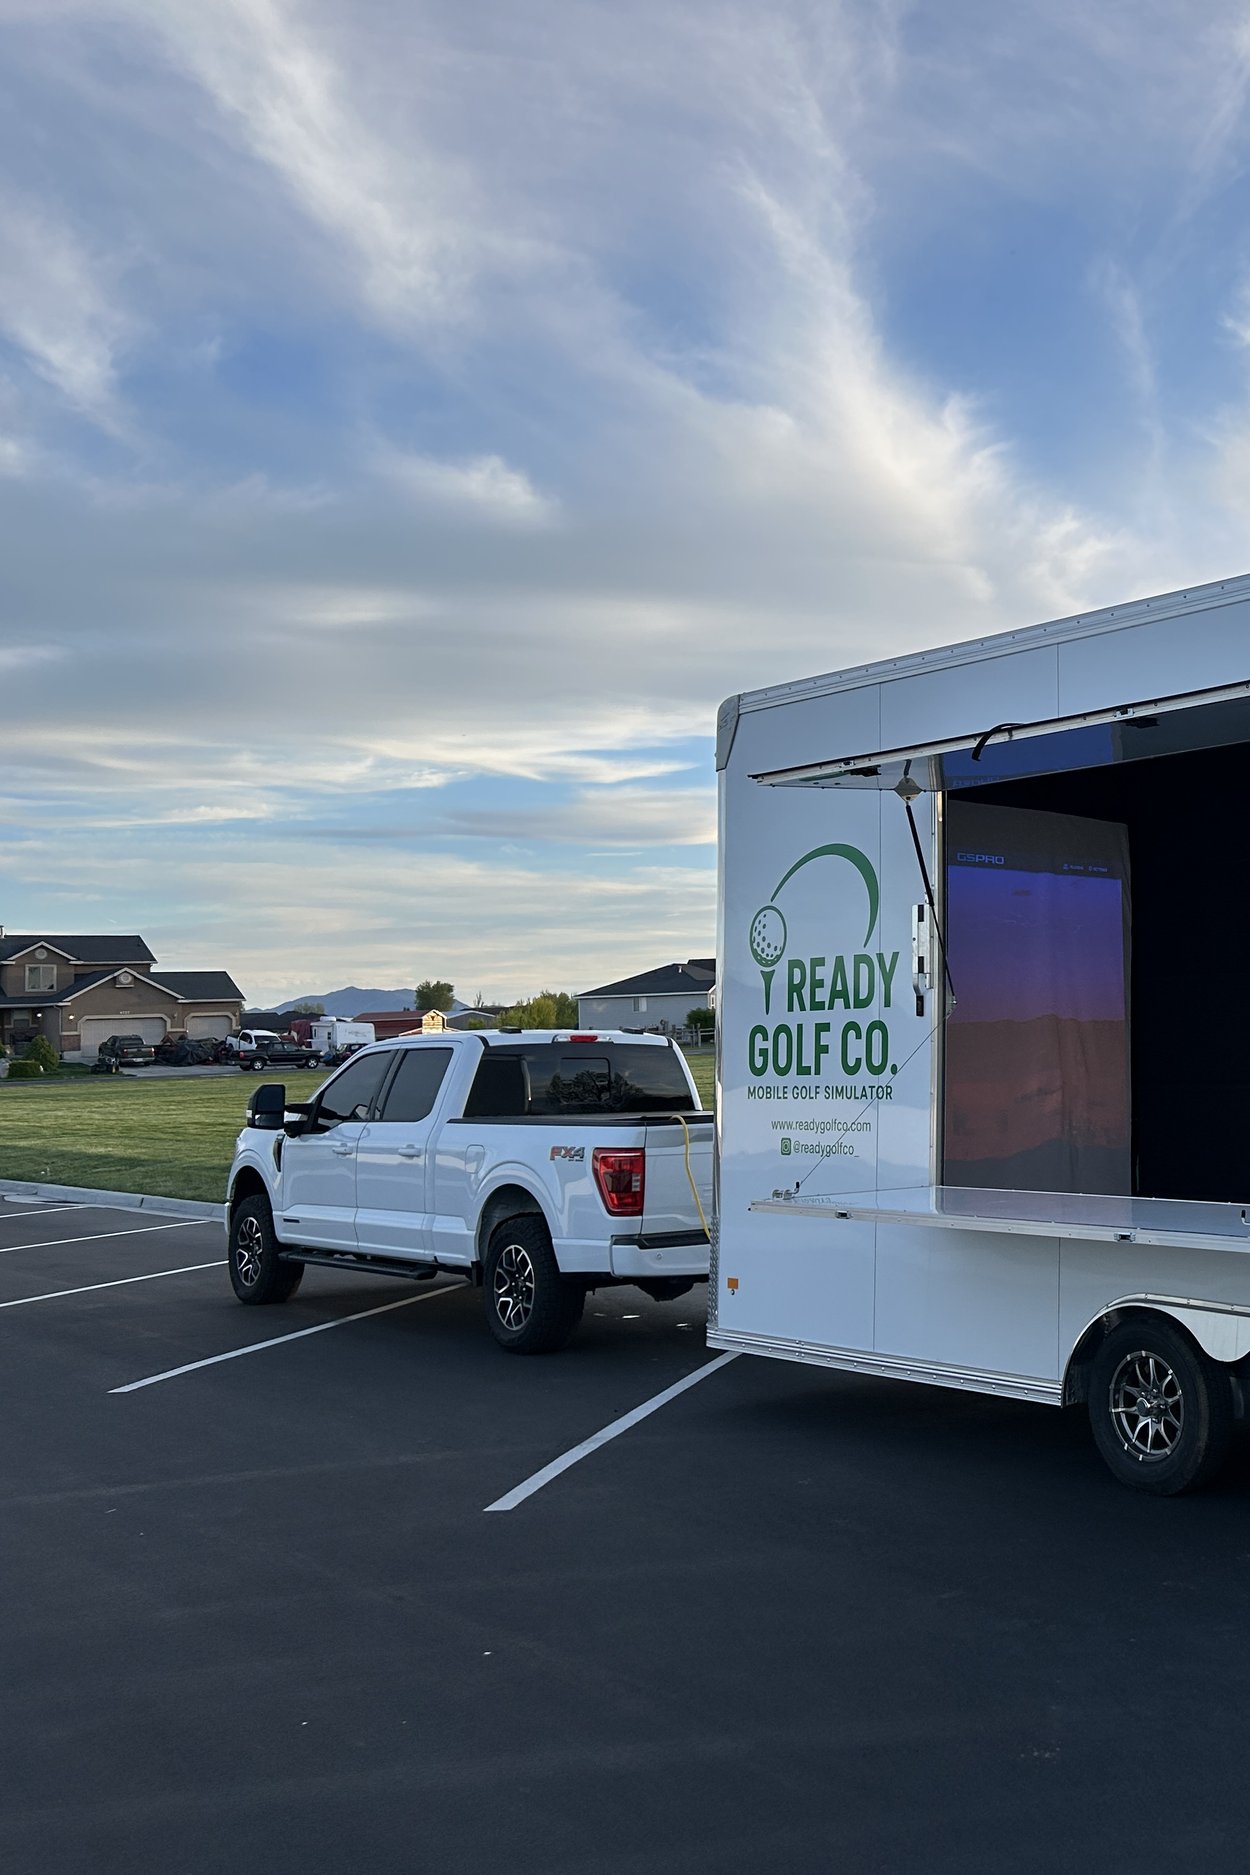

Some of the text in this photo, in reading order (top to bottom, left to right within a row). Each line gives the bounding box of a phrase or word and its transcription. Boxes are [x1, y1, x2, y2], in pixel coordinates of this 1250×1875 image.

[957, 852, 1005, 866] GSPRO
[786, 951, 900, 1013] READY
[748, 1019, 898, 1078] GOLF CO.
[747, 1085, 893, 1101] MOBILE GOLF SIMULATOR
[771, 1118, 872, 1135] www.readygolfco.com
[550, 1145, 585, 1161] FX4
